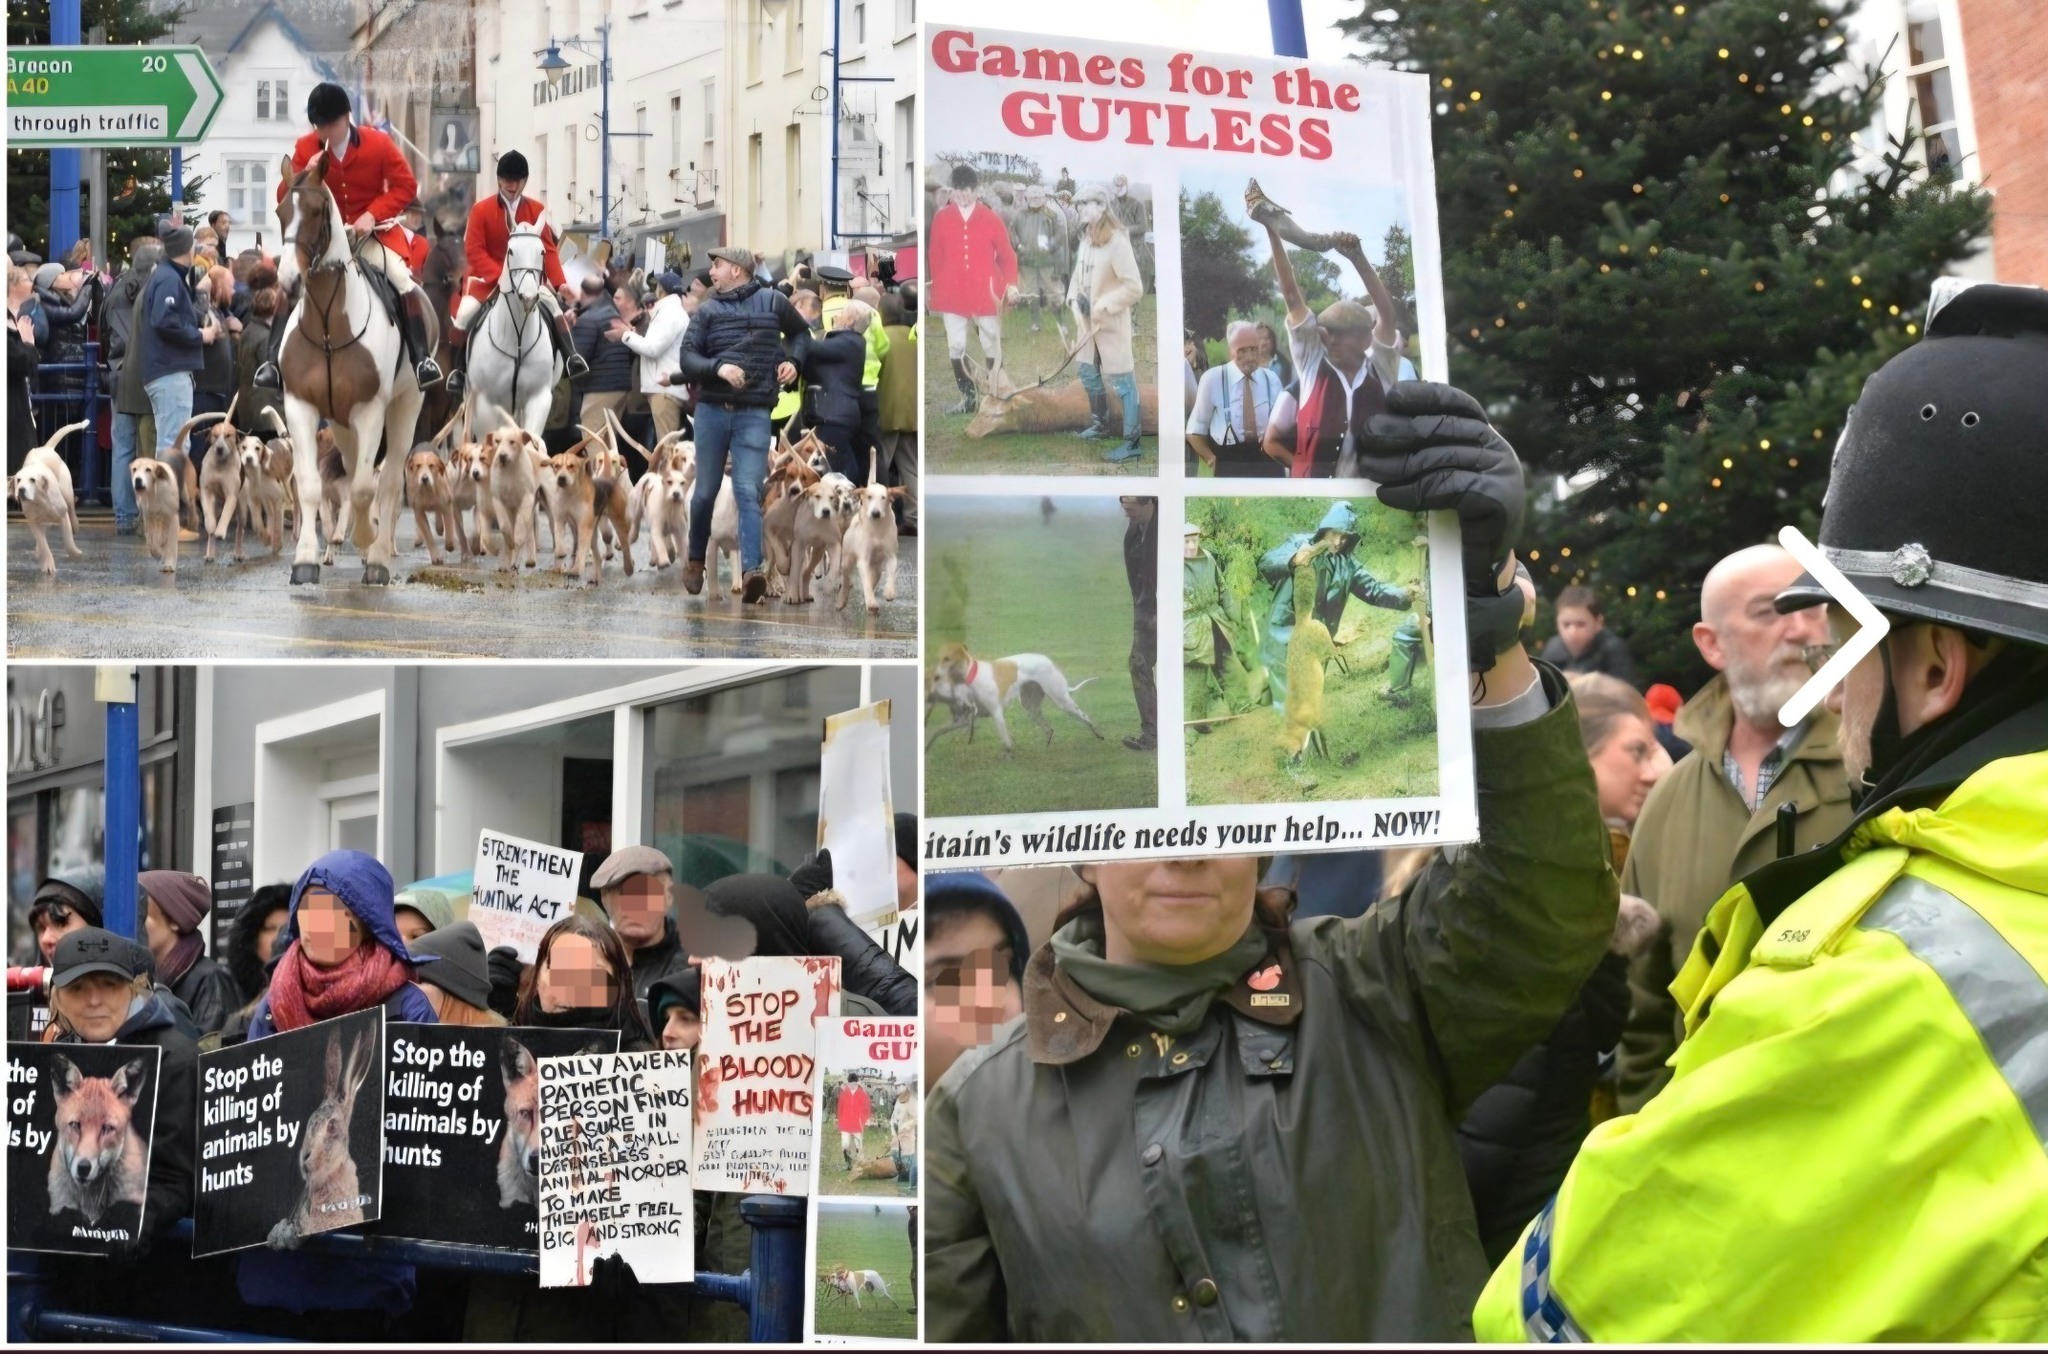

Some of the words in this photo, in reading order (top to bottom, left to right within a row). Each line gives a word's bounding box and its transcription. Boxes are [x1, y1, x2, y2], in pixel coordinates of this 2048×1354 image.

[142, 56, 168, 73] 20
[931, 30, 1146, 89] Games
[1167, 52, 1253, 99] for
[1272, 67, 1361, 112] the
[14, 114, 91, 133] through
[99, 113, 160, 130] traffic
[1001, 90, 1334, 160] GUTLESS
[1022, 823, 1126, 854] wildlife
[1134, 819, 1208, 849] needs
[1214, 823, 1277, 849] your
[1284, 815, 1363, 843] help...
[1372, 810, 1441, 838] NOW!
[482, 838, 573, 878] STRENGTHEN
[496, 864, 520, 886] THE
[472, 885, 523, 914] HUNTING
[527, 894, 561, 920] ACT
[1777, 929, 1811, 943] 598
[726, 989, 800, 1020] STOP
[729, 1018, 783, 1045] THE
[391, 1038, 445, 1072] Stop
[448, 1040, 486, 1068] the
[540, 1057, 603, 1081] ONLY
[628, 1052, 689, 1072] WEAK
[720, 1054, 814, 1085] BLOODY
[204, 1065, 249, 1093] Stop
[251, 1053, 284, 1082] the
[388, 1070, 454, 1107] killing
[456, 1075, 485, 1102] of
[540, 1073, 646, 1105] PATHETIC
[13, 1091, 37, 1116] of
[203, 1095, 258, 1127] killing
[262, 1081, 284, 1112] of
[540, 1095, 630, 1124] PERSON
[633, 1087, 690, 1113] FINDS
[732, 1088, 814, 1117] HUNTS
[25, 1122, 52, 1155] by
[202, 1120, 272, 1160] animals
[276, 1115, 301, 1148] by
[384, 1106, 468, 1135] animals
[471, 1108, 502, 1145] by
[540, 1115, 636, 1146] PLEASURE
[648, 1112, 667, 1129] IN
[383, 1137, 443, 1167] hunts
[540, 1137, 604, 1160] HURTING
[607, 1135, 620, 1152] A
[622, 1130, 679, 1151] SMALL
[540, 1146, 650, 1176] DEFENSELESS
[202, 1162, 254, 1193] hunts
[540, 1171, 606, 1193] ANIMAL
[631, 1159, 689, 1182] ORDER
[541, 1194, 565, 1213] TO
[569, 1186, 622, 1208] MAKE
[541, 1203, 631, 1231] THEMSELF
[637, 1202, 682, 1218] FEEL
[543, 1230, 575, 1251] BIG
[585, 1224, 619, 1246] AND
[621, 1219, 682, 1240] STRONG
